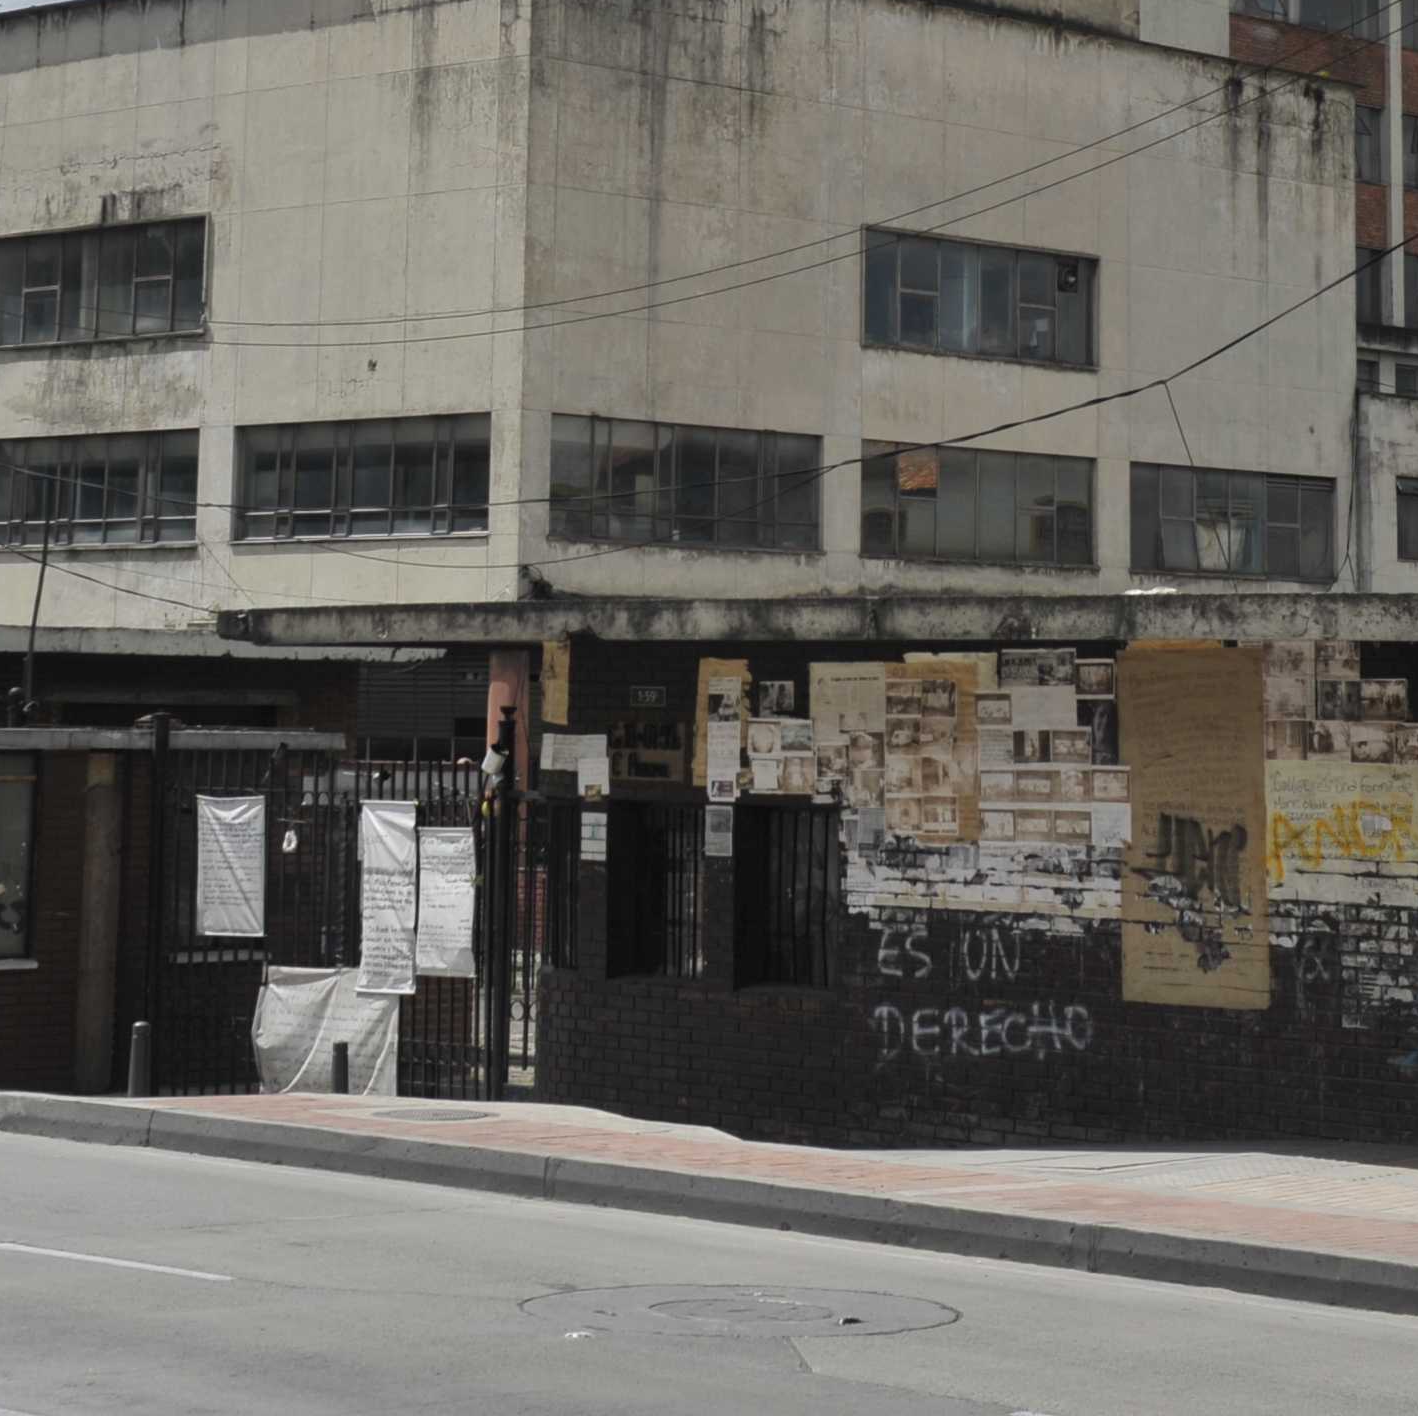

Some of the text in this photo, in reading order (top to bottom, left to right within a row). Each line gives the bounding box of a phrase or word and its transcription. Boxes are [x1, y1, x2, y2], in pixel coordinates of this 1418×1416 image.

[877, 927, 1020, 980] ES UN
[875, 1000, 1093, 1060] DERECHO
